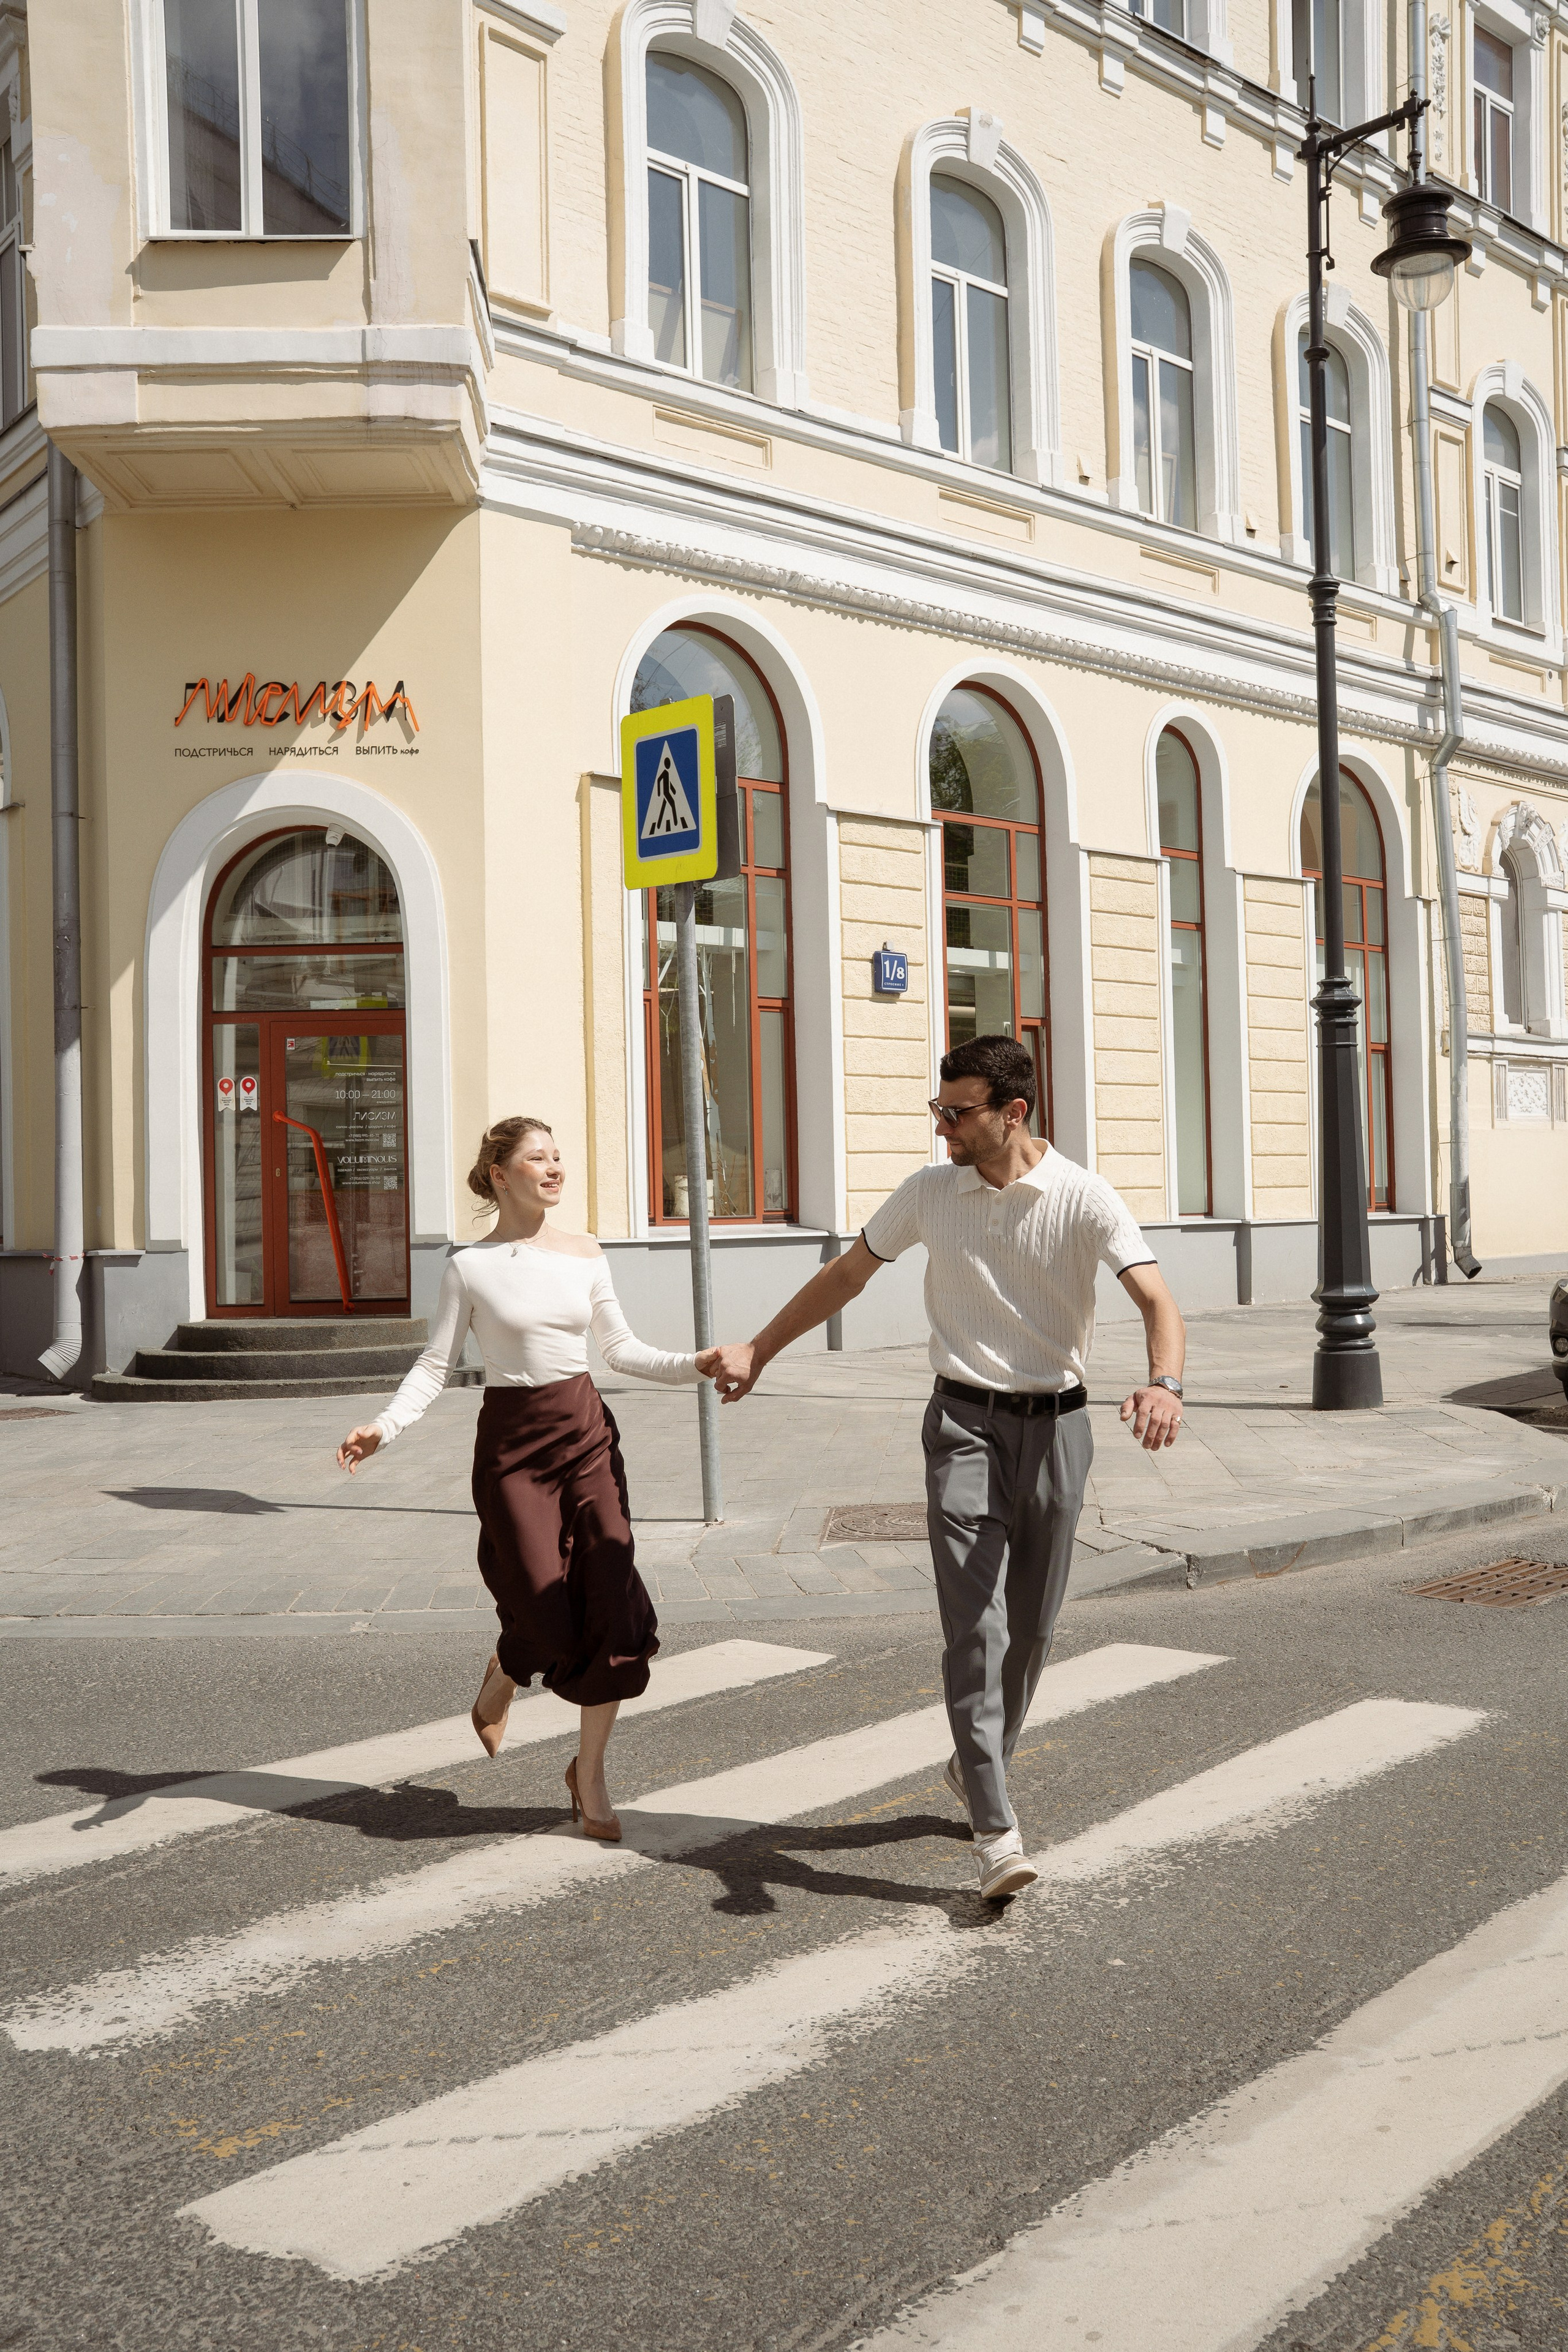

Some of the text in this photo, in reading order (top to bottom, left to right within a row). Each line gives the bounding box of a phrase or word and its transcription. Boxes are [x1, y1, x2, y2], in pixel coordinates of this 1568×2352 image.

[175, 747, 254, 758] ПОДСТРИЧЬСЯ
[269, 746, 339, 756] НАРЯДИТЬСЯ
[355, 745, 398, 756] ВЫПИТЬ
[884, 960, 905, 981] 1/8
[335, 1090, 361, 1099] 10:00
[371, 1090, 396, 1099] 21:00
[353, 1112, 396, 1120] ЛИСИЗМ
[337, 1155, 398, 1164] VOLUMINOUS
